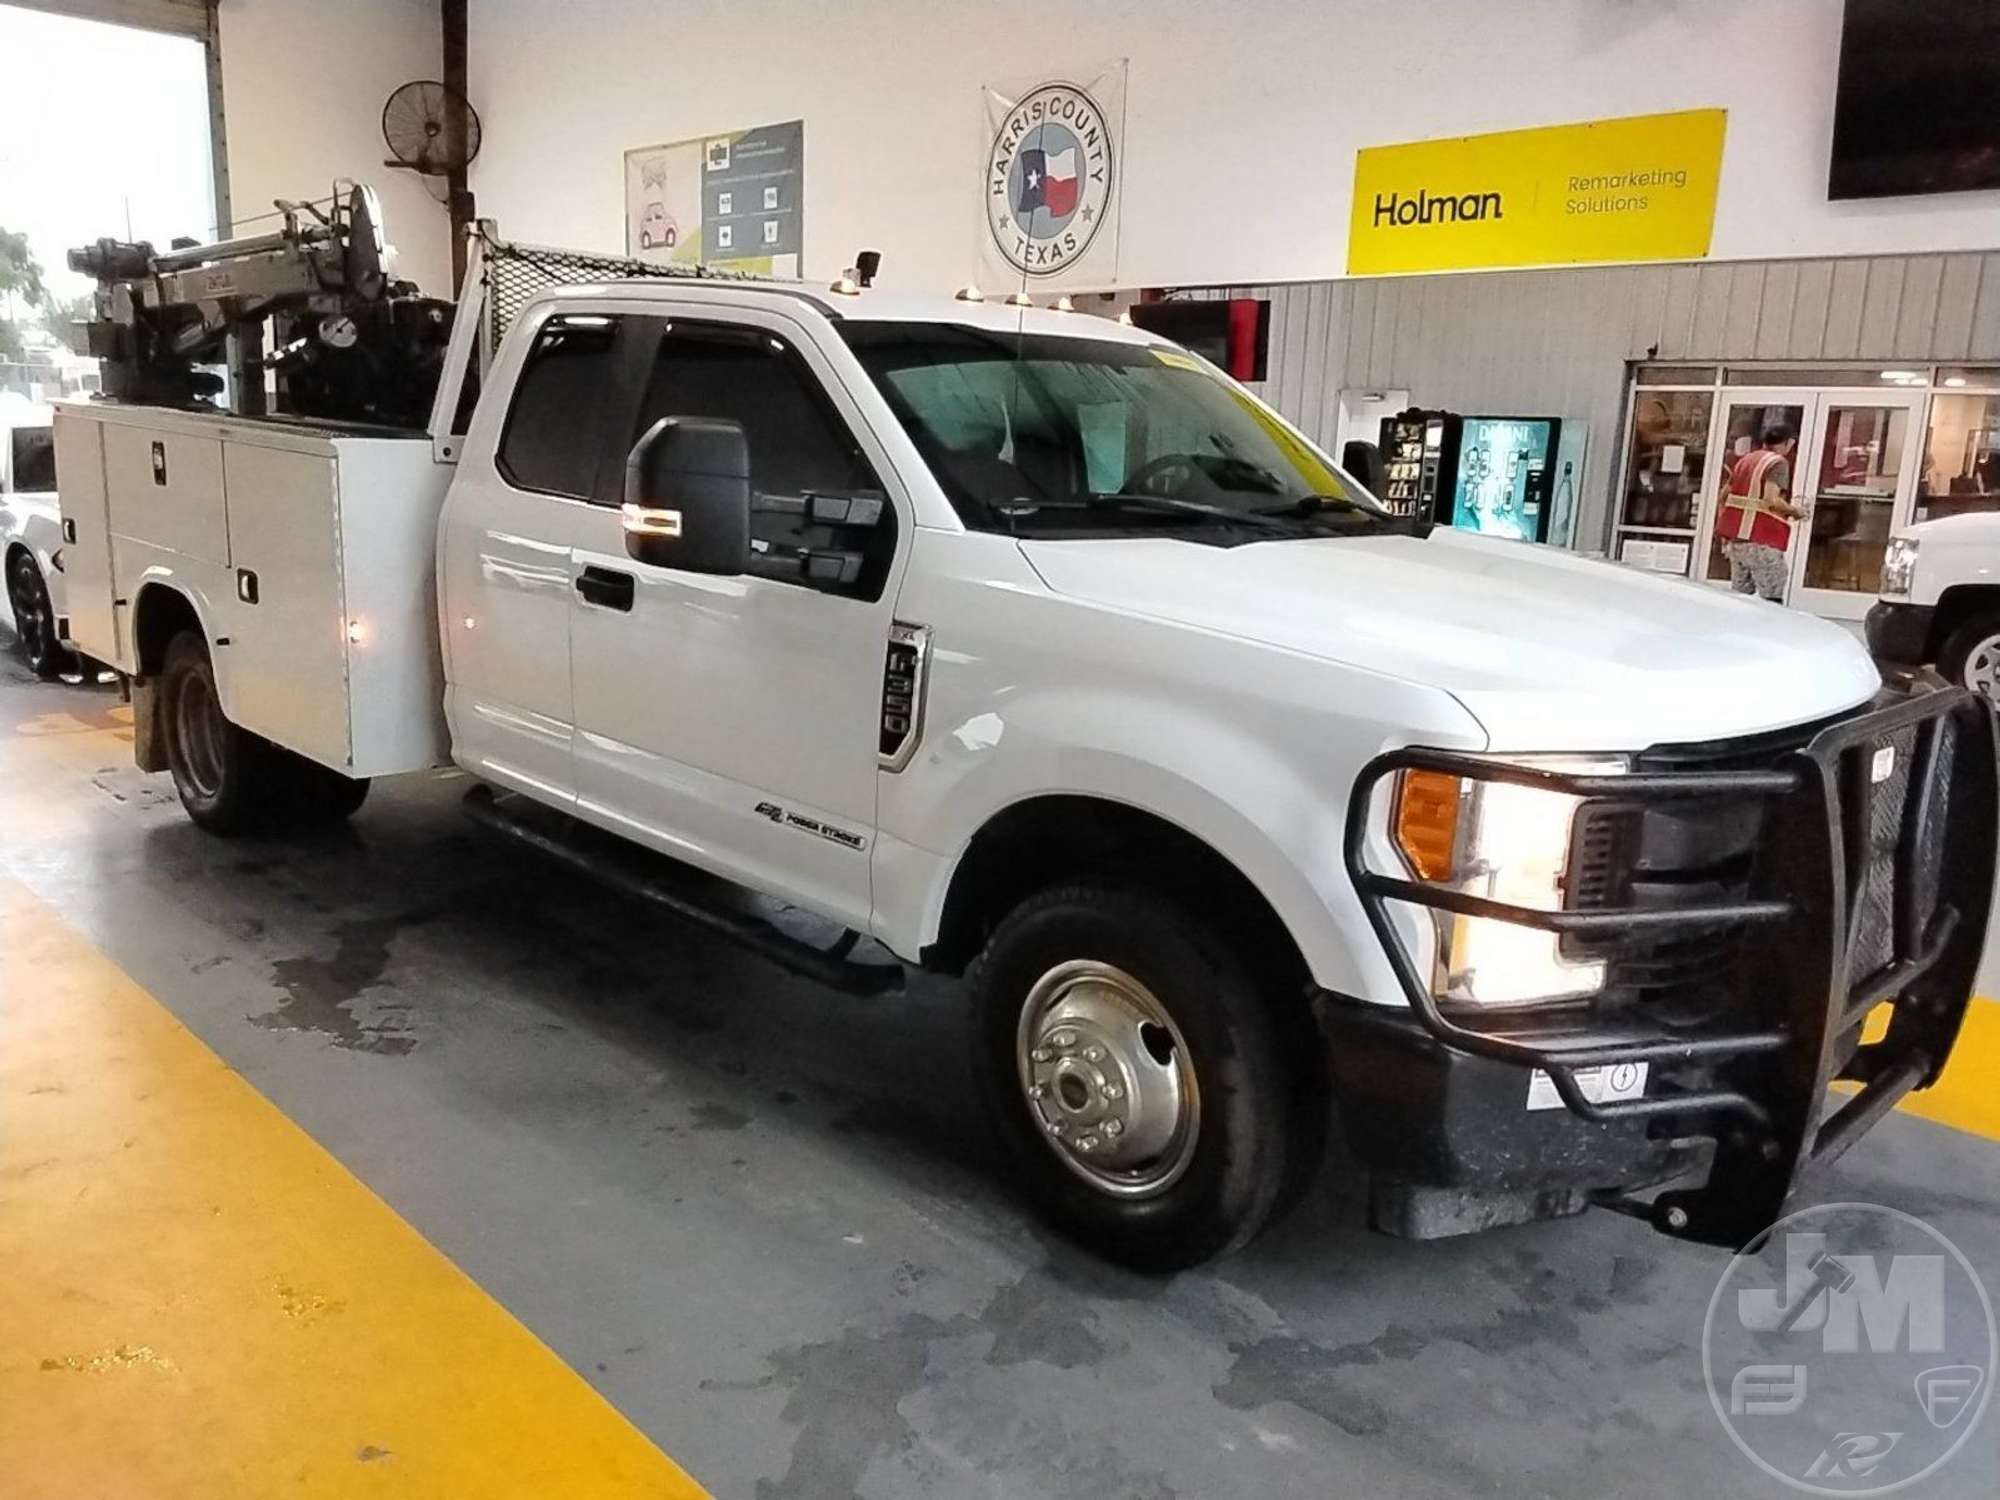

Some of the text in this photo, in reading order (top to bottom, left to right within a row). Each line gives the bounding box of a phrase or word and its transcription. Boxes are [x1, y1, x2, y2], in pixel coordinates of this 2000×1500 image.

[993, 96, 1104, 196] HARRIS COUNTY
[1567, 168, 1688, 193] Remarketing
[1373, 188, 1503, 228] Holman
[1565, 194, 1649, 216] Solutions
[1014, 232, 1077, 265] TEXAS
